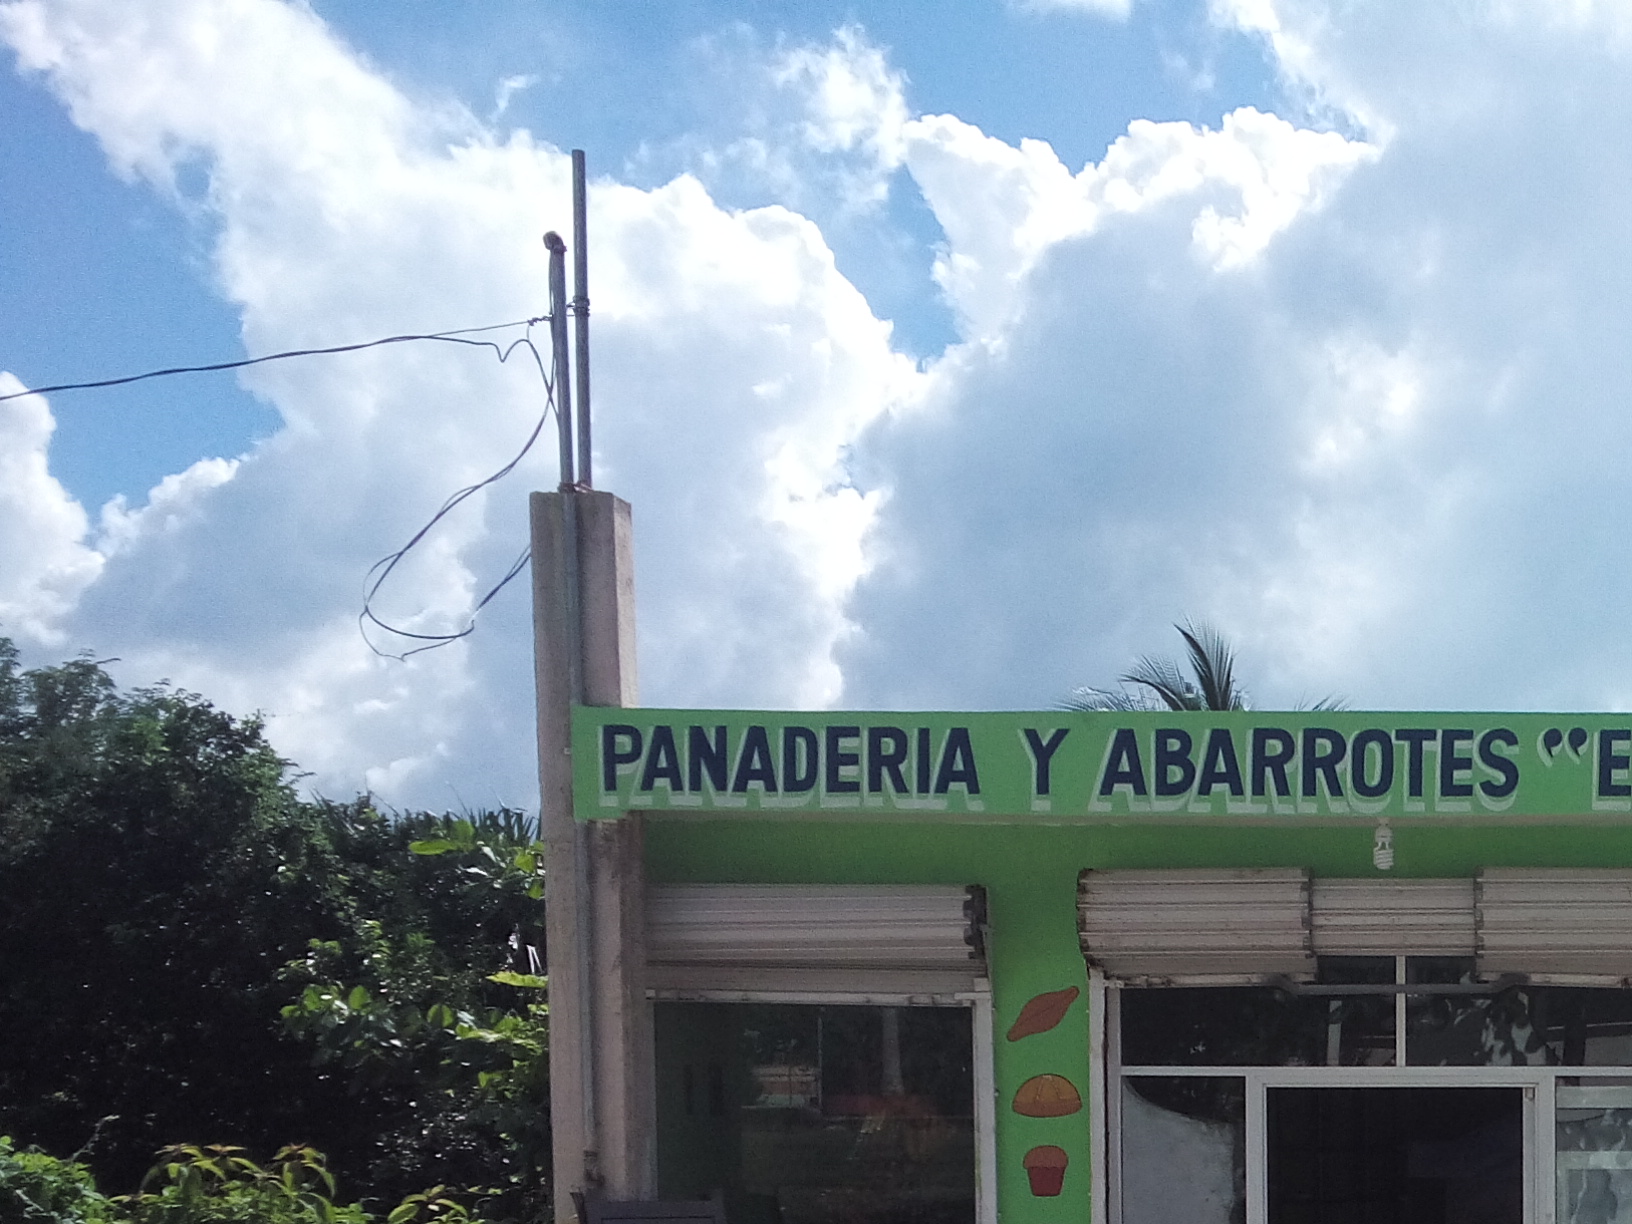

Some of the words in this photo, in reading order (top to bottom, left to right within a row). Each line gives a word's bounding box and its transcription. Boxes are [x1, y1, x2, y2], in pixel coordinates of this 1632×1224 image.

[602, 724, 981, 795] PANADERIA
[1023, 728, 1071, 796] Y
[1099, 727, 1520, 798] ABARROTES
